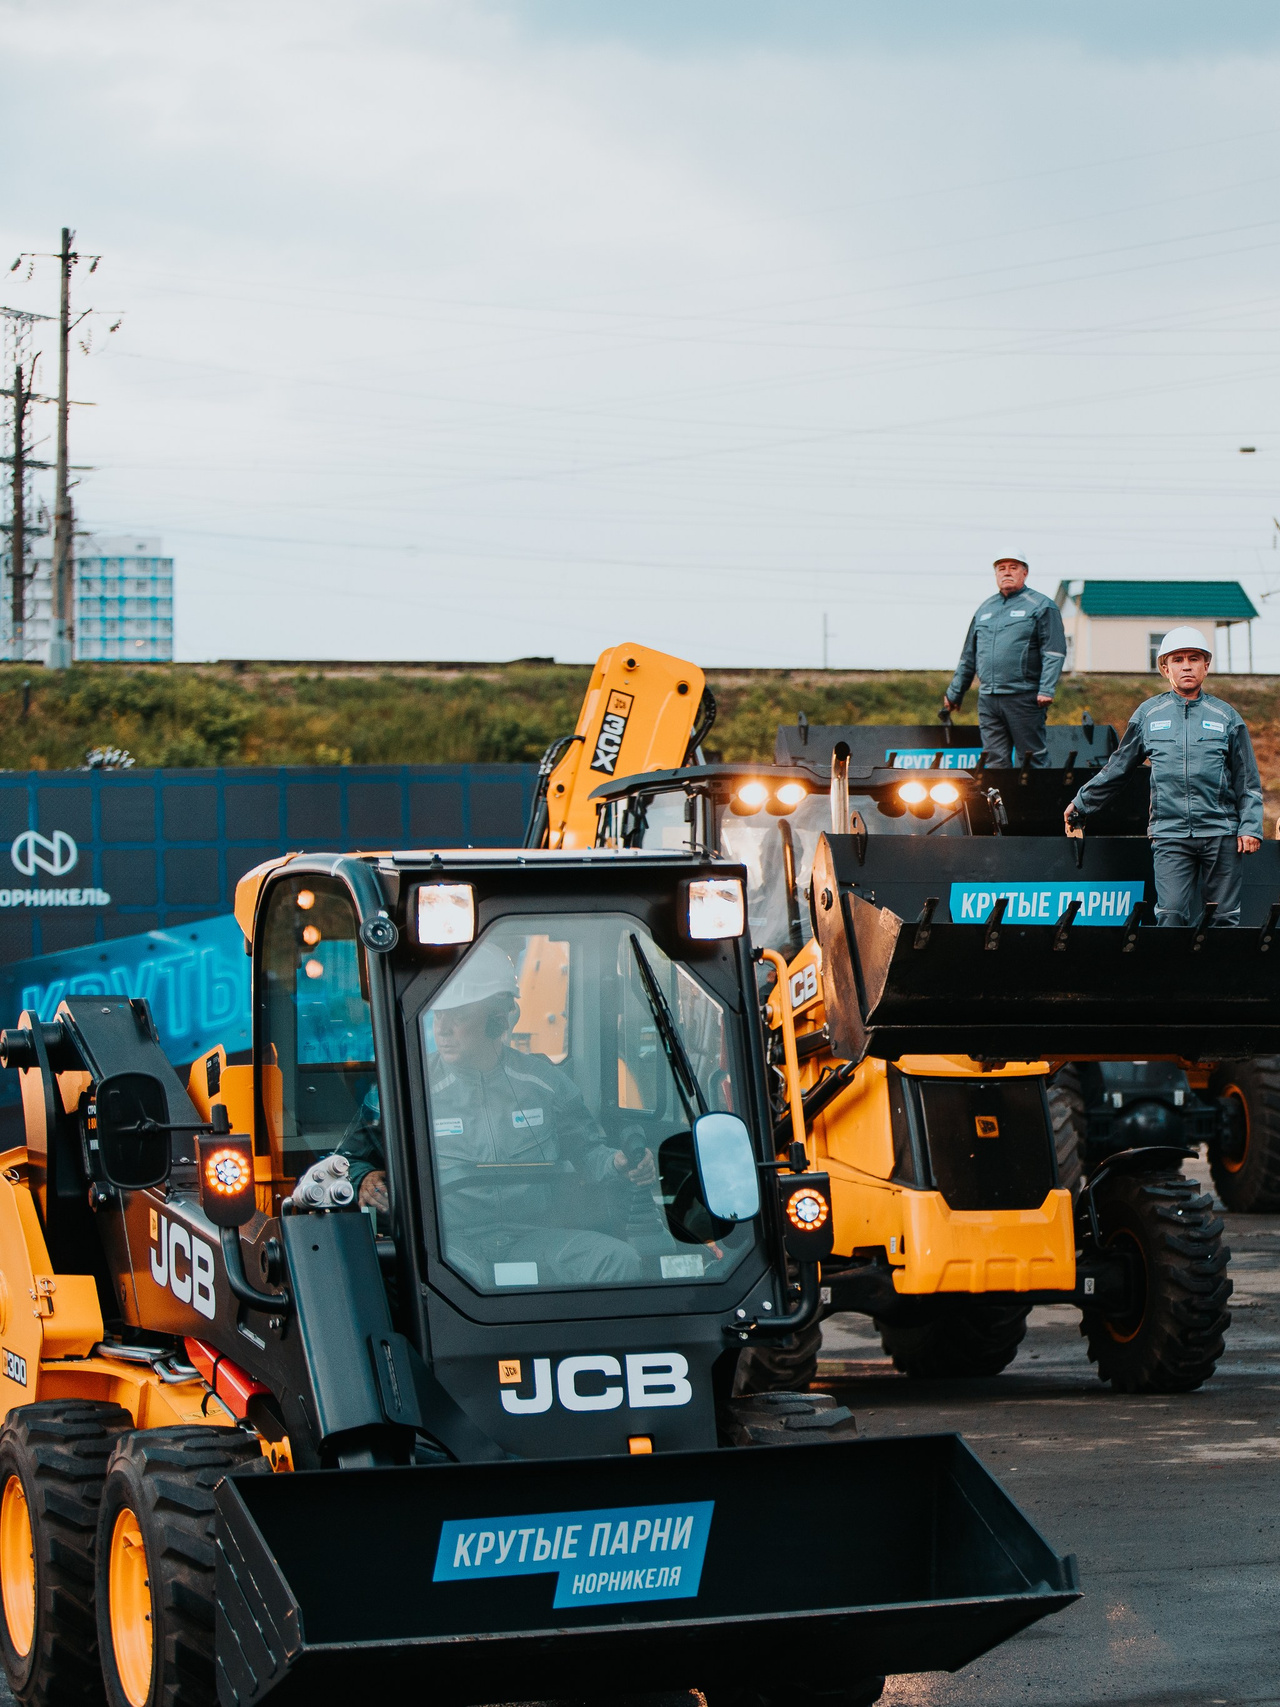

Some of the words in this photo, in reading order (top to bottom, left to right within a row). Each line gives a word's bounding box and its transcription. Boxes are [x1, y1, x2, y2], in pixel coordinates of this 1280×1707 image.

[591, 714, 626, 772] 3CX
[0, 888, 111, 907] ОРНИКЕЛЬ
[1057, 891, 1131, 917] ПАРНИ
[788, 963, 818, 1008] CB
[149, 1213, 217, 1321] JCB
[8, 1351, 27, 1386] 300
[500, 1352, 692, 1414] JCB
[453, 1524, 582, 1568] КРУТЫЕ
[588, 1515, 694, 1557] ПАРНИ
[571, 1566, 682, 1596] НОРНИКЕЛЯ
